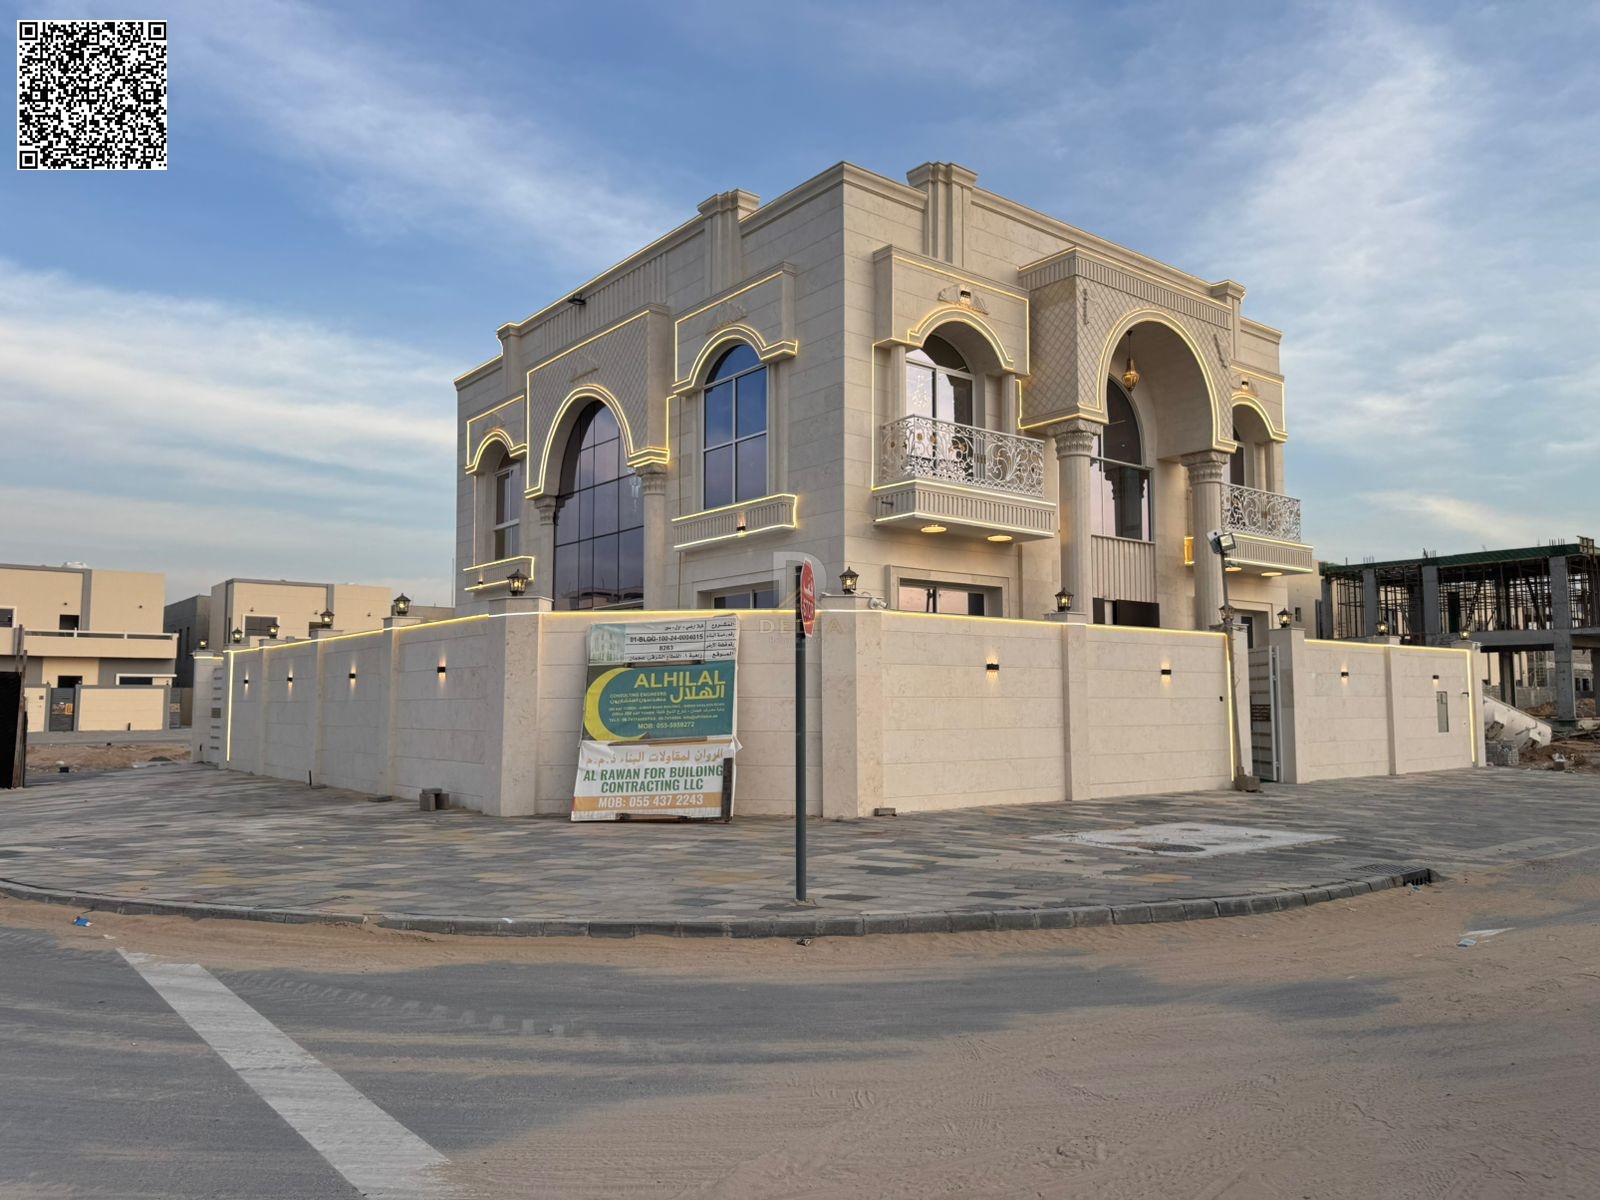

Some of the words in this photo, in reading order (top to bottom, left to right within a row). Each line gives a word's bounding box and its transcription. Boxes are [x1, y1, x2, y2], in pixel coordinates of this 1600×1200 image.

[634, 670, 726, 688] ALHILAL
[670, 684, 725, 704] الهلال
[620, 752, 645, 763] البناء
[694, 748, 723, 764] الروان
[583, 770, 597, 782] AL
[600, 767, 641, 781] RAWAN
[643, 767, 666, 780] FOR
[669, 764, 724, 779] BUILDING
[600, 780, 680, 793] CONTRACTING
[683, 778, 704, 791] LLC
[598, 796, 626, 809] MOB:
[629, 796, 650, 808] 055
[652, 794, 672, 807] 437
[676, 793, 704, 807] 2243
